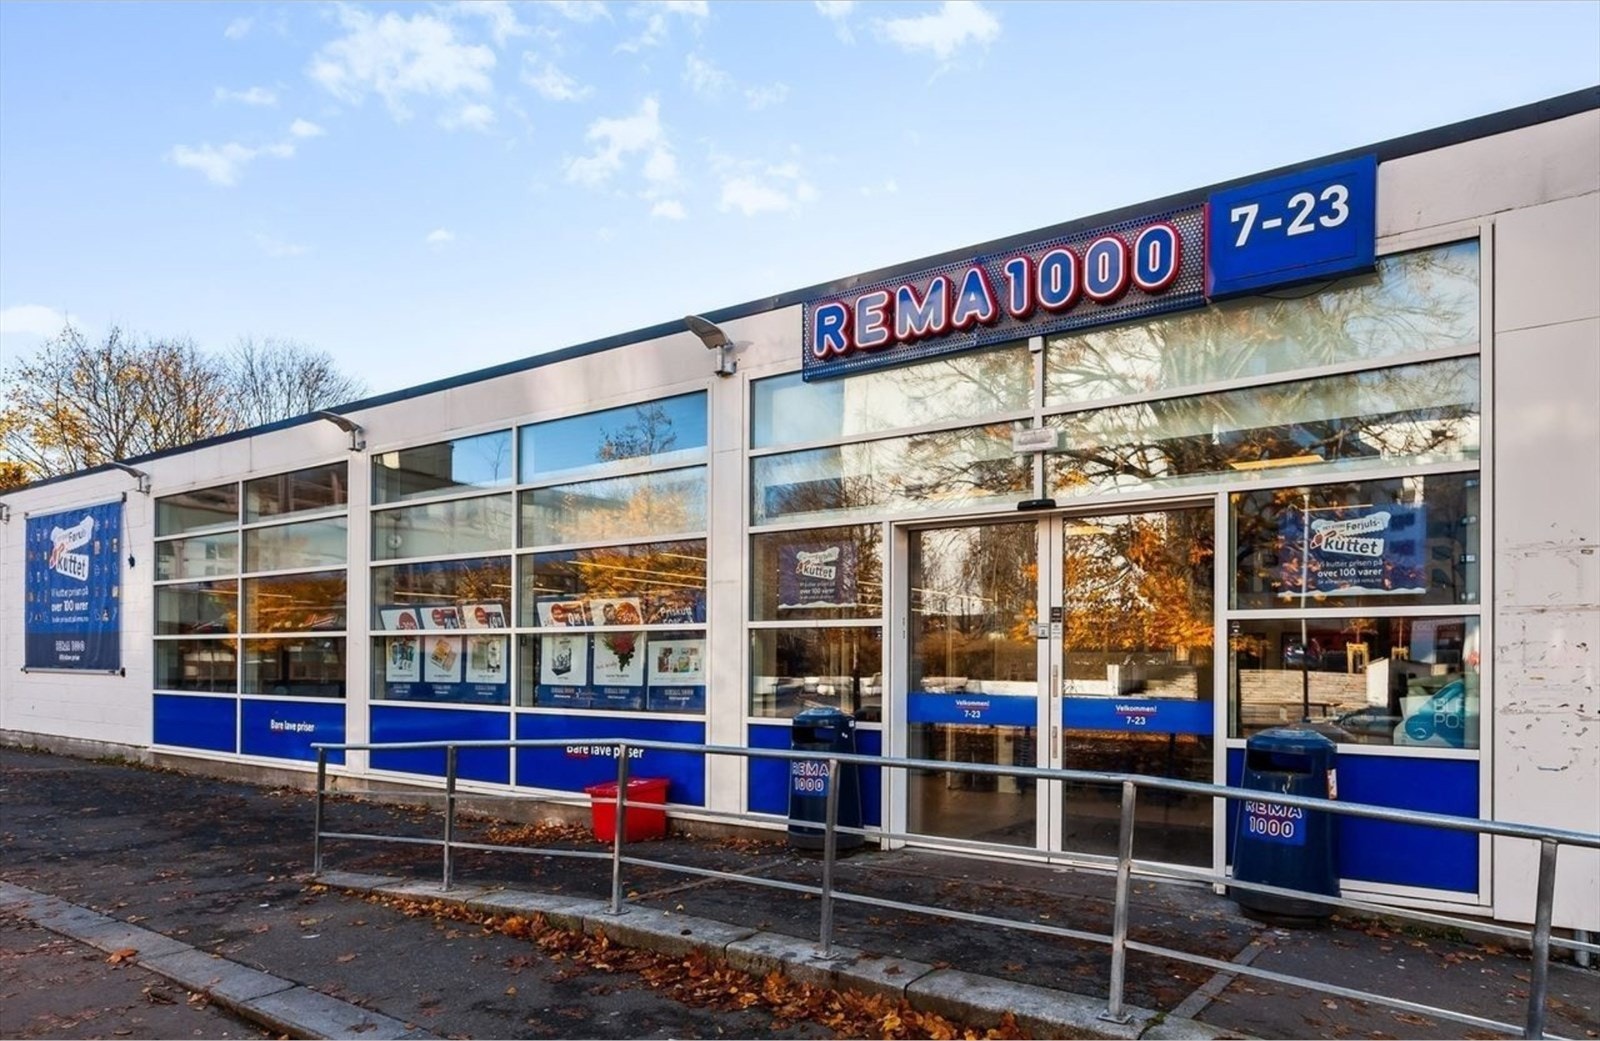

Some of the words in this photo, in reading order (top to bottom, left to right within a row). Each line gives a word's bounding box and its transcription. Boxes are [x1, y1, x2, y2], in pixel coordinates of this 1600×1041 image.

[1231, 184, 1349, 247] 7-23
[813, 266, 995, 357] REMA
[1003, 222, 1181, 318] 1000
[1323, 537, 1378, 554] kuttet
[1374, 558, 1383, 566] på
[804, 566, 832, 577] kuttet
[1340, 568, 1356, 577] 100
[1358, 568, 1383, 576] varer
[955, 699, 990, 707] Velkommen!
[1115, 704, 1157, 713] Velkommen!
[964, 710, 981, 719] 7-23
[1126, 716, 1146, 725] 7-23
[613, 747, 644, 759] pser
[792, 761, 829, 777] REMA
[794, 776, 825, 792] 1000
[1245, 801, 1303, 819] REMA
[1249, 816, 1294, 838] 1000
